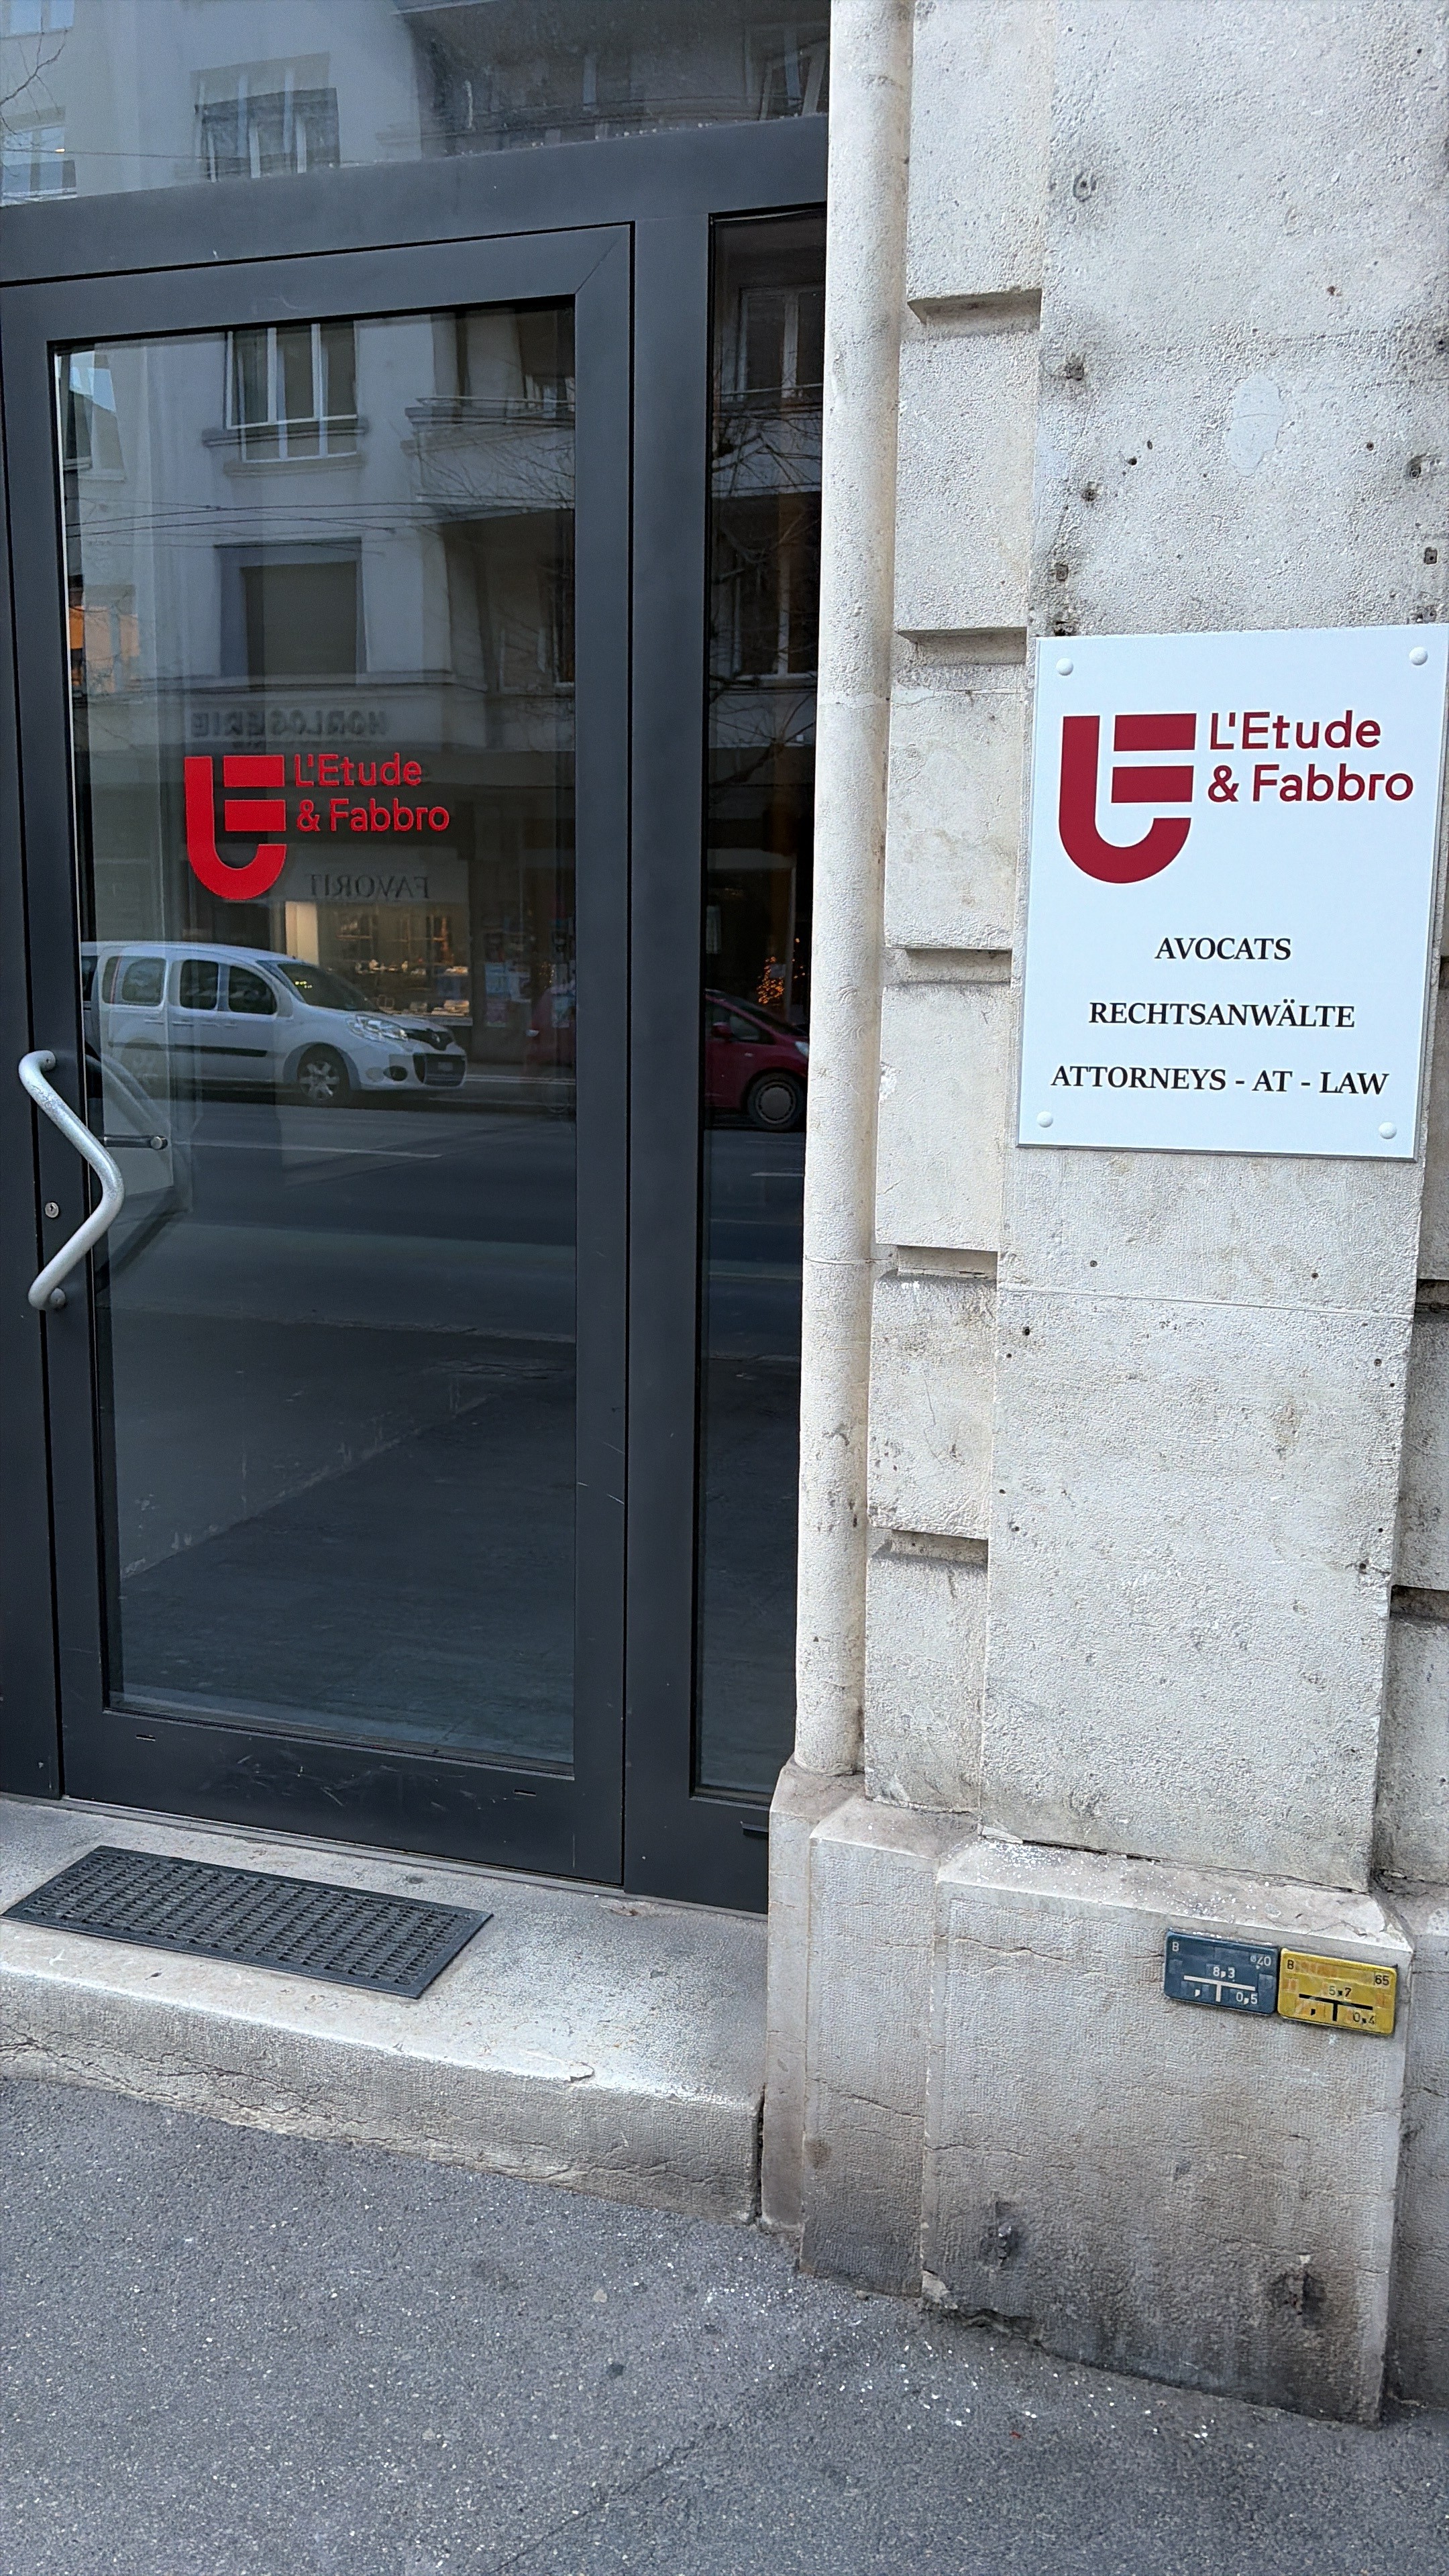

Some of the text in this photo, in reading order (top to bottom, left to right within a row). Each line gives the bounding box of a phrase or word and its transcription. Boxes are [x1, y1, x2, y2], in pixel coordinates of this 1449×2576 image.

[1211, 711, 1381, 750] L'Etude
[294, 753, 422, 787] L'Etude
[1208, 763, 1413, 803] & Fabbro
[296, 798, 449, 833] & Fabbro
[1155, 936, 1292, 961] AVOCATS
[1088, 998, 1356, 1028] RECHTSANWÄLTE
[1051, 1065, 1226, 1091] ATTORNEYS
[1252, 1069, 1293, 1093] AT
[1319, 1071, 1391, 1095] LAW
[1172, 1941, 1179, 1951] B
[1287, 1960, 1294, 1970] B
[1375, 1974, 1389, 1986] 65
